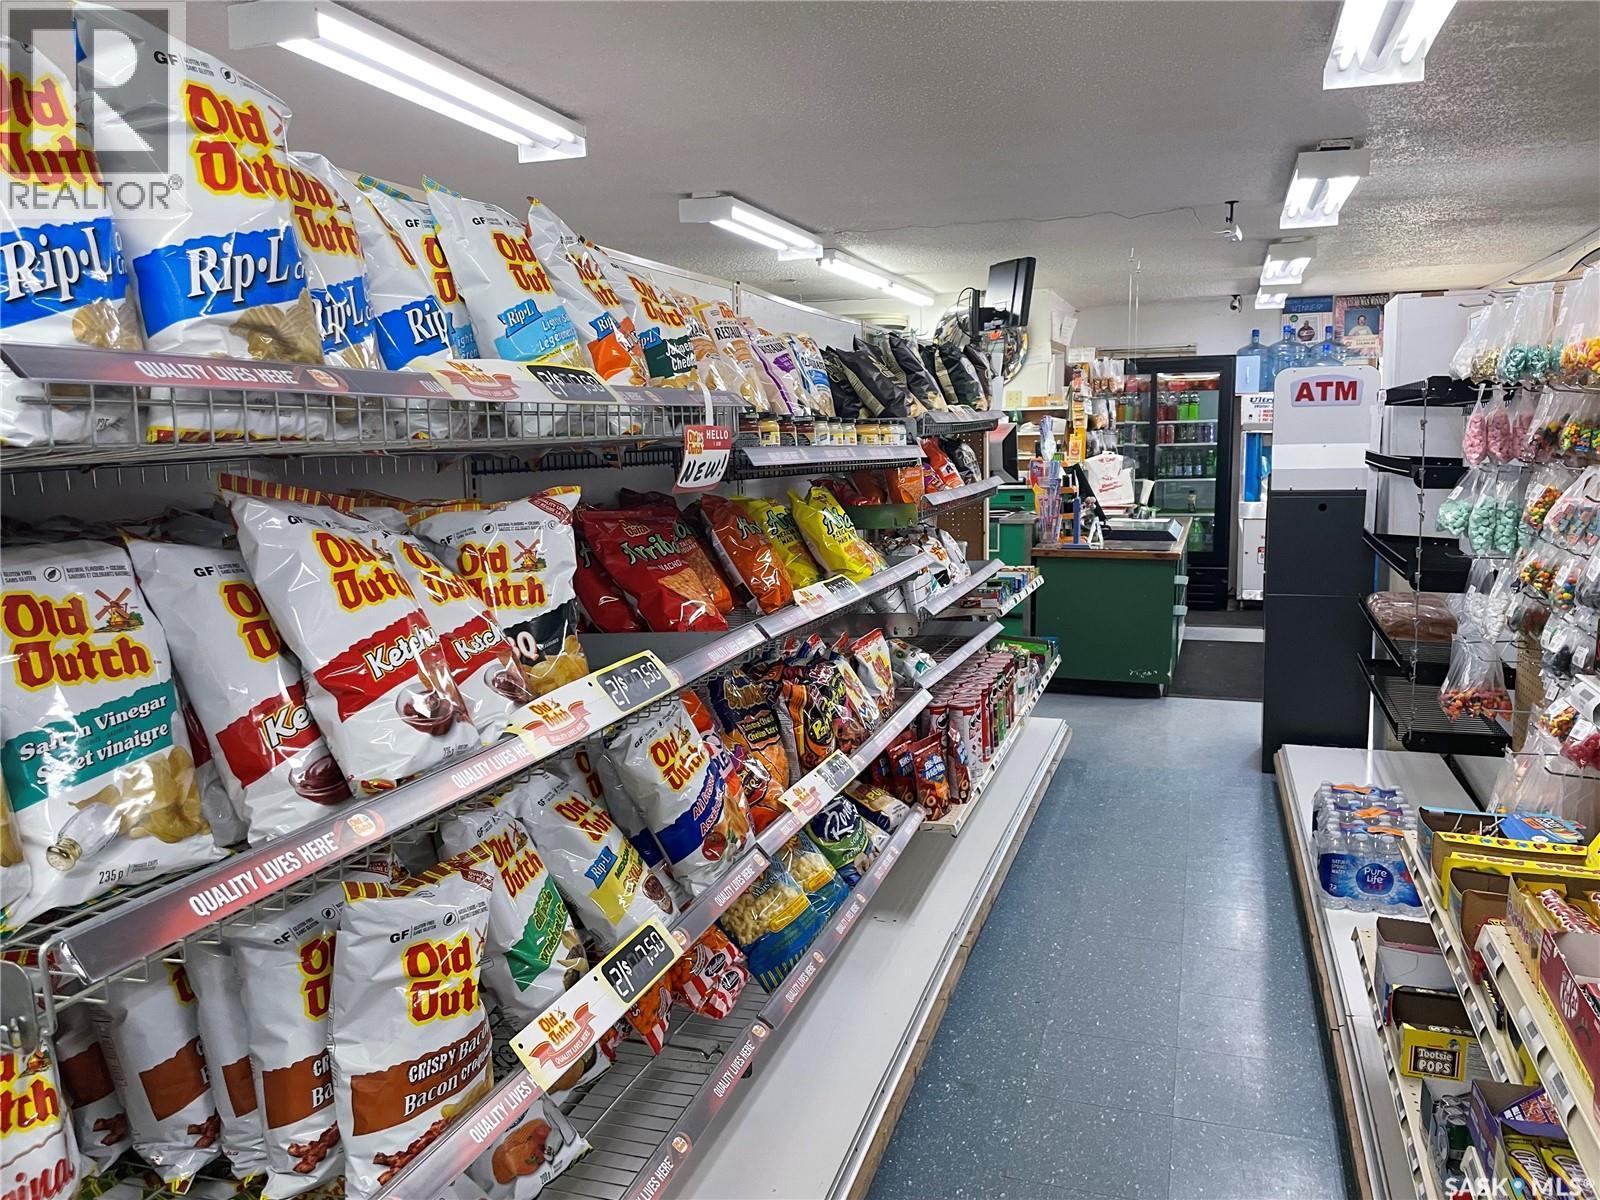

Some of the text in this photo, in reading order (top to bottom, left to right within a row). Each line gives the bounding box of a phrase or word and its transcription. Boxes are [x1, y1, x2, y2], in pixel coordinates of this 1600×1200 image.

[186, 85, 269, 146] Old
[286, 167, 334, 209] Old
[494, 233, 537, 263] Old
[629, 275, 658, 304] Old
[135, 361, 299, 385] QUALITY LIVES HERE
[1295, 381, 1358, 401] ATM
[706, 429, 729, 440] HELLO
[679, 453, 727, 485] NEW!
[315, 533, 376, 568] Old
[457, 543, 508, 576] Old
[194, 566, 215, 577] GF
[2, 594, 89, 638] Old
[14, 636, 150, 688] Dutch
[604, 661, 662, 706] 2/$ 7.50
[94, 694, 167, 731] Vinegar
[528, 701, 551, 715] Old
[543, 707, 571, 726] Dutch
[96, 722, 169, 760] vinaigre
[651, 733, 680, 768] Old
[450, 759, 493, 789] QUALITY
[489, 749, 518, 771] LIVES
[512, 744, 531, 759] HE
[554, 796, 588, 824] Old
[489, 832, 516, 868] Old
[188, 832, 339, 917] QUALITY LIVES HERE
[501, 851, 544, 898] Dutch
[1364, 866, 1388, 878] Pure
[1366, 875, 1384, 884] Life
[390, 928, 410, 944] GF
[405, 937, 472, 978] Old
[608, 931, 666, 998] 2/$ 7.50
[538, 1013, 559, 1032] Old
[548, 1020, 577, 1045] Dutch
[409, 1048, 457, 1083] CRISPY
[554, 1049, 574, 1065] QUALITY
[713, 1039, 756, 1099] QUALITY LIVES HERE
[1418, 1048, 1453, 1061] Tootsie
[1418, 1060, 1452, 1074] POPS
[403, 1073, 459, 1117] Bacon
[469, 1080, 533, 1144] QUALITY LIVES
[640, 1155, 674, 1200] LIVES HERE
